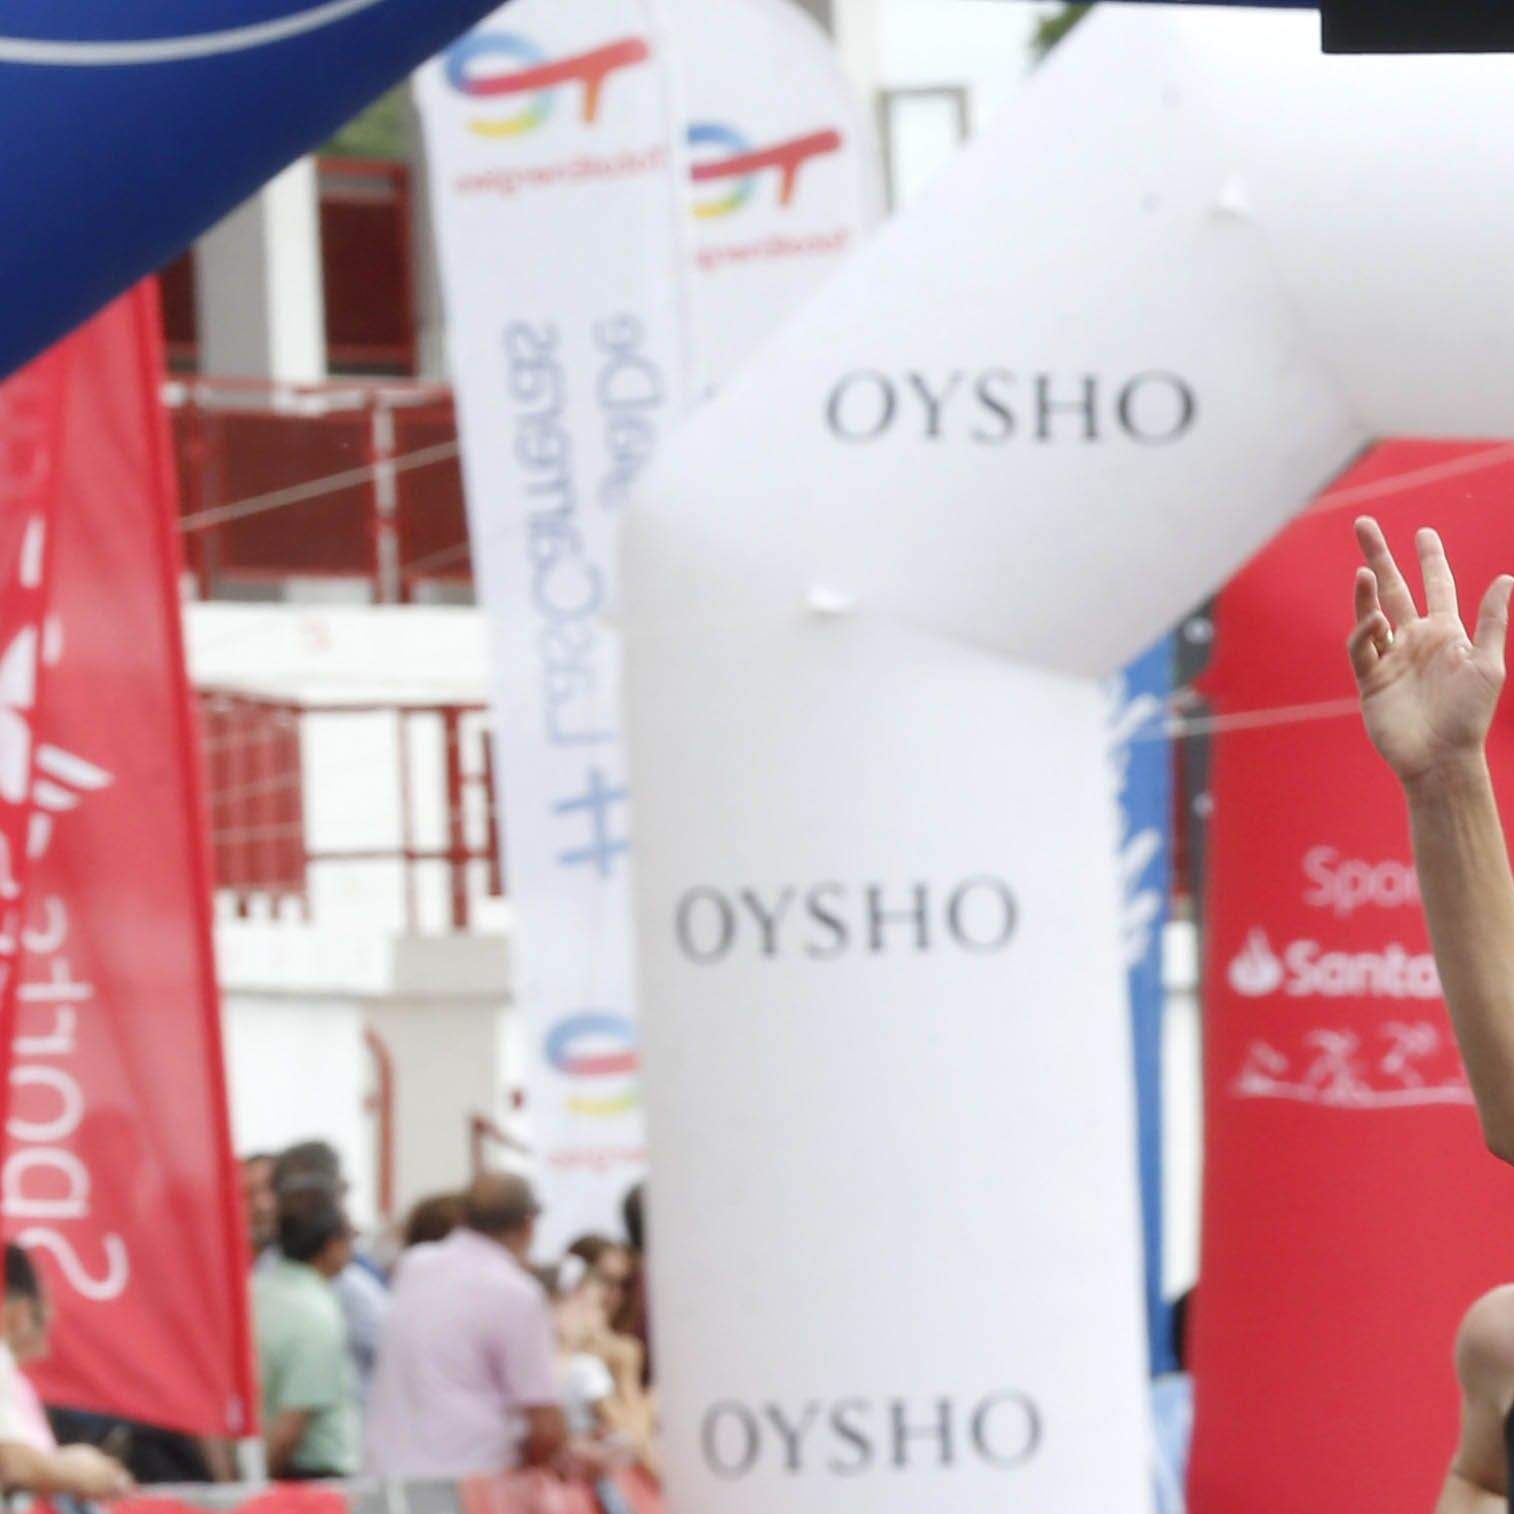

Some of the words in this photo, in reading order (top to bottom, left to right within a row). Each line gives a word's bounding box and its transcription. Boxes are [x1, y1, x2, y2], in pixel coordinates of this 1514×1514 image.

[823, 368, 1199, 446] OYSHO
[674, 874, 1019, 966] OYSHO
[1302, 845, 1420, 918] Spor
[701, 1387, 1043, 1482] OYSHO
